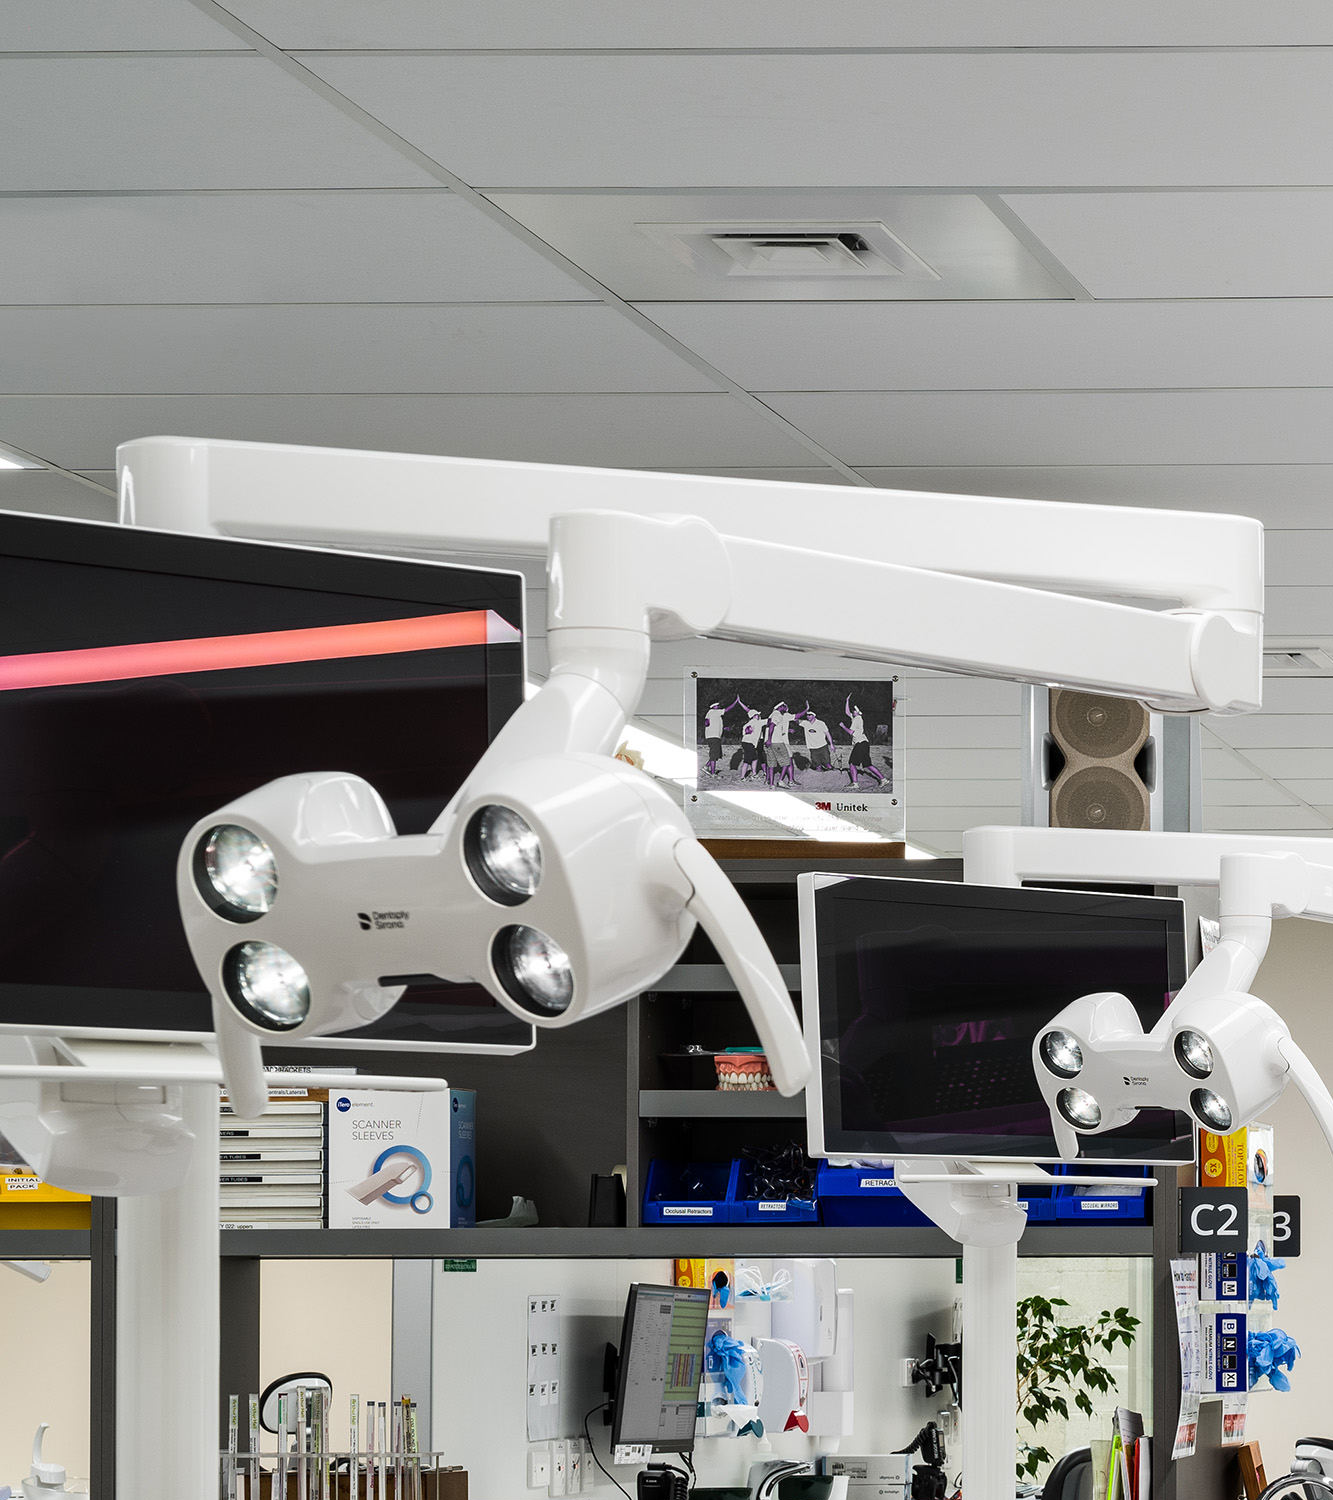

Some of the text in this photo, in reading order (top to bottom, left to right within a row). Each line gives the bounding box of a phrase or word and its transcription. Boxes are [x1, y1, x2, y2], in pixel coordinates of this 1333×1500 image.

[815, 802, 868, 812] 3M Unitek
[352, 1120, 402, 1129] SCANNER
[352, 1131, 394, 1140] SLEEVES
[1209, 1162, 1218, 1174] XS
[1236, 1162, 1244, 1187] GLOV
[760, 1202, 786, 1210] RETRACTORS
[1191, 1204, 1239, 1236] C2
[1273, 1211, 1292, 1241] 3
[1227, 1284, 1235, 1293] M
[1227, 1323, 1235, 1331] B
[1227, 1374, 1235, 1386] XL
